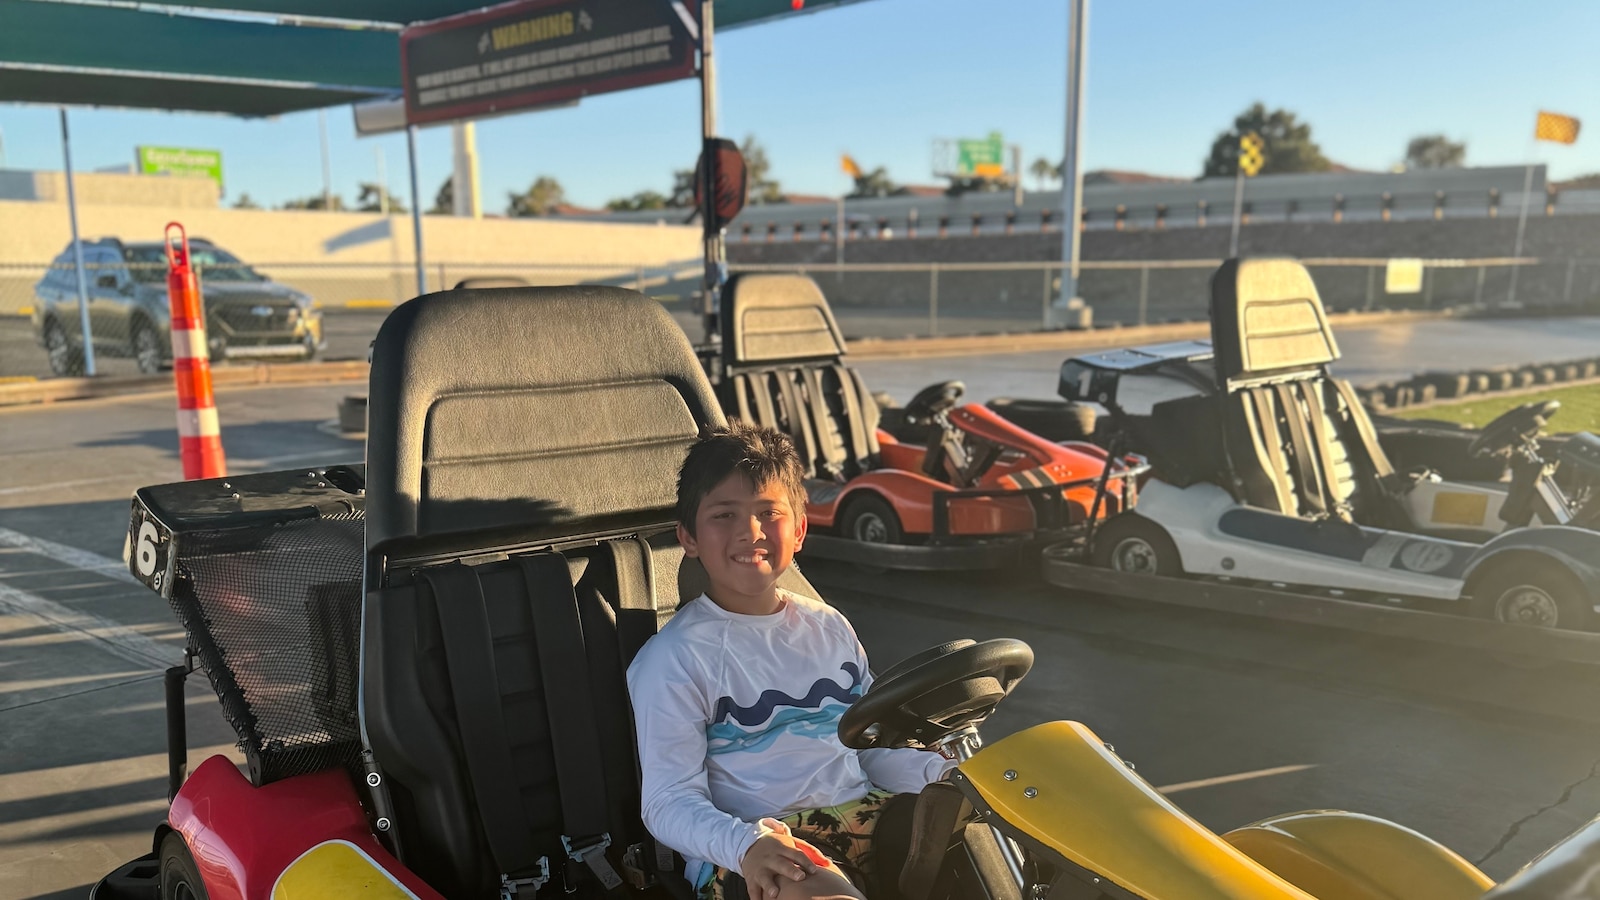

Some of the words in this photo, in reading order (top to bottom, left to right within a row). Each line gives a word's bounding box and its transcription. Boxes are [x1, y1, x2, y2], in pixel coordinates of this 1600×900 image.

[492, 11, 573, 51] WARNING
[1078, 370, 1092, 397] 1
[137, 521, 158, 576] 6
